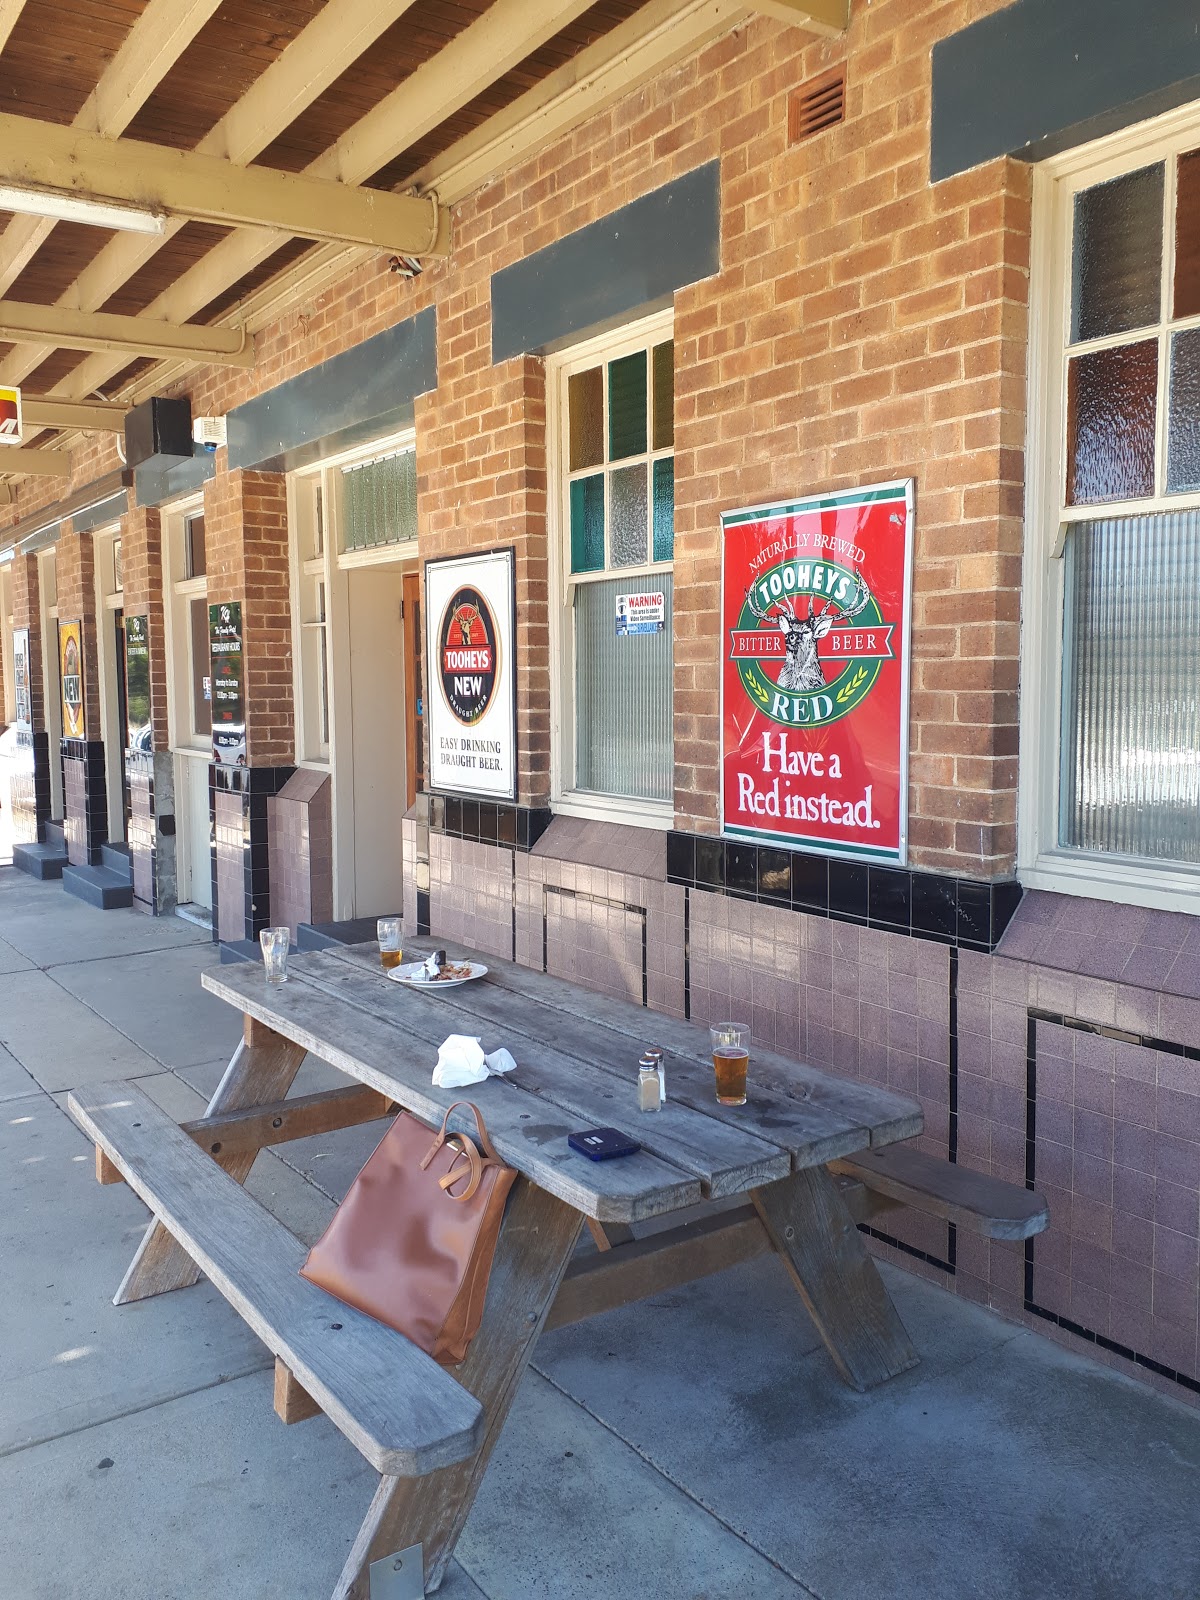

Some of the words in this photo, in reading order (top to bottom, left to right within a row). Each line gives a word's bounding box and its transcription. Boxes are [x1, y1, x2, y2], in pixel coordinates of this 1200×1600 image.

[748, 533, 811, 574] NATURALLY
[812, 533, 866, 563] BREWED
[758, 564, 851, 604] TOOHEYS
[629, 594, 662, 608] WARNING
[739, 636, 782, 651] BITTER
[832, 634, 877, 651] BEER
[446, 650, 489, 669] TOOHEYS
[64, 677, 80, 701] NEW
[454, 676, 483, 697] NEW
[450, 695, 473, 717] DRAUGHT
[475, 695, 487, 714] BEER
[770, 691, 834, 723] RED
[440, 737, 458, 750] EASY
[461, 738, 501, 754] DRINKING
[762, 731, 824, 777] Have
[828, 754, 842, 779] a
[441, 753, 476, 768] DRAUGHT
[479, 757, 503, 771] BEER.
[737, 772, 782, 818] Red
[784, 780, 881, 830] instead.
